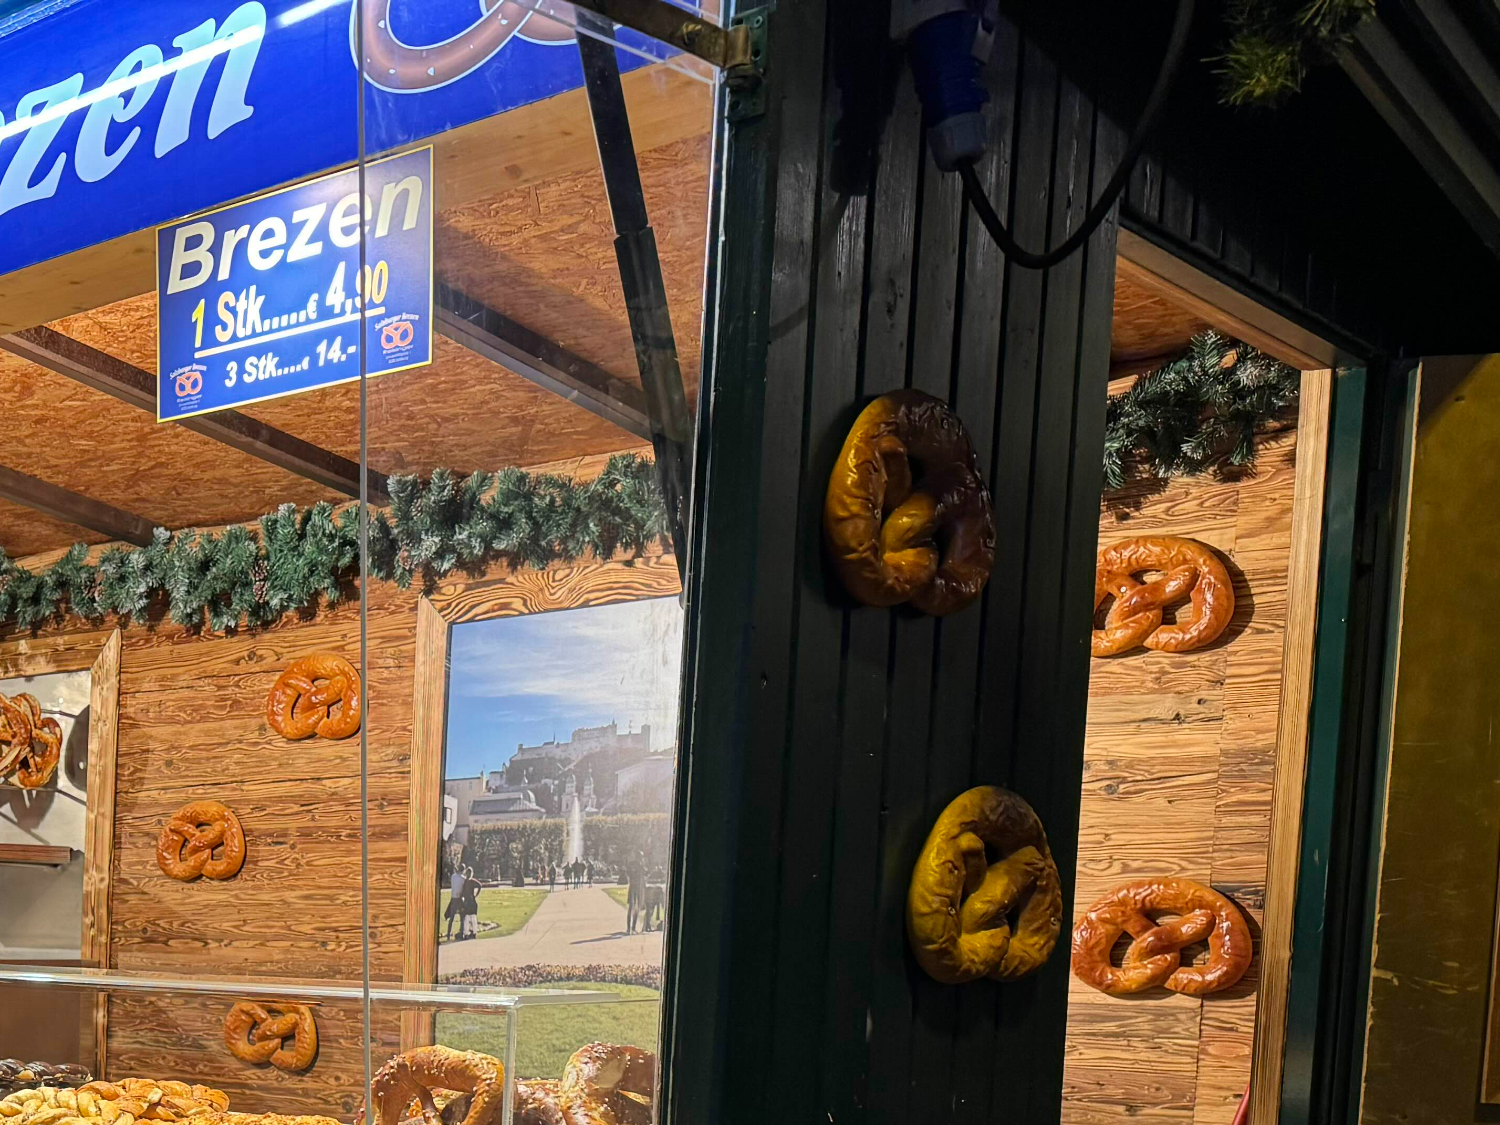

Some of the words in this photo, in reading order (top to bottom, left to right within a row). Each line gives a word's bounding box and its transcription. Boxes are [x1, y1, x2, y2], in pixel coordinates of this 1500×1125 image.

[166, 175, 423, 295] Brezen
[191, 299, 205, 348] 1
[325, 260, 389, 316] 4,90
[224, 361, 237, 388] 3
[316, 336, 356, 367] 14.-
